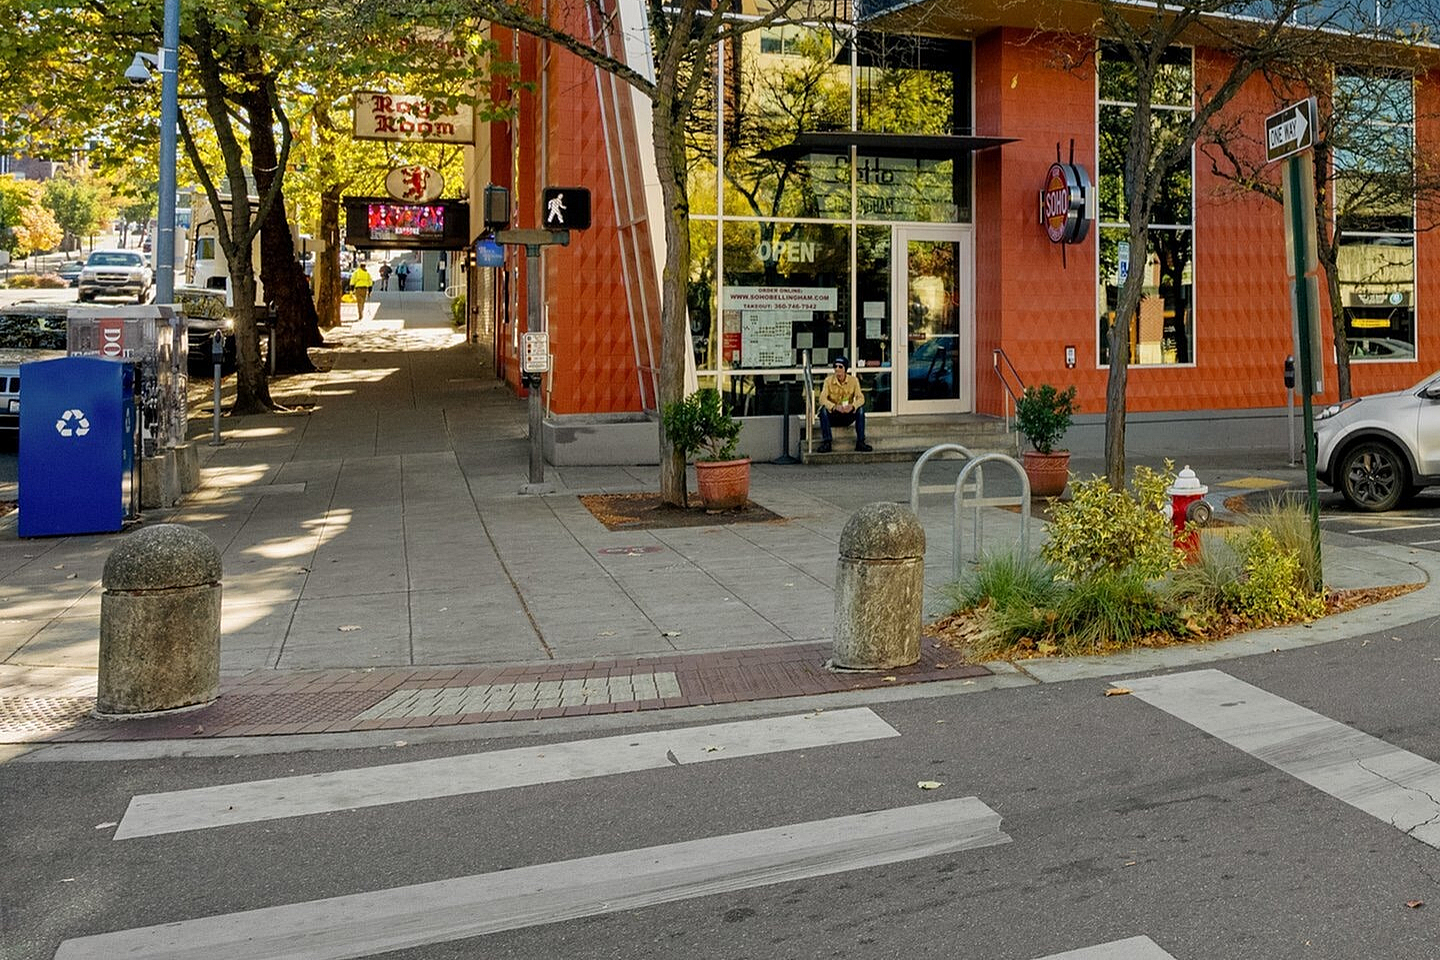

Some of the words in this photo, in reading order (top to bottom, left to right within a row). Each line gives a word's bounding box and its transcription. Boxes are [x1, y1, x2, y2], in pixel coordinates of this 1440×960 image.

[375, 115, 455, 135] Room
[1270, 126, 1283, 146] ONE
[1285, 119, 1297, 142] WAY
[1046, 189, 1068, 218] SOHO
[757, 240, 815, 263] OPEN
